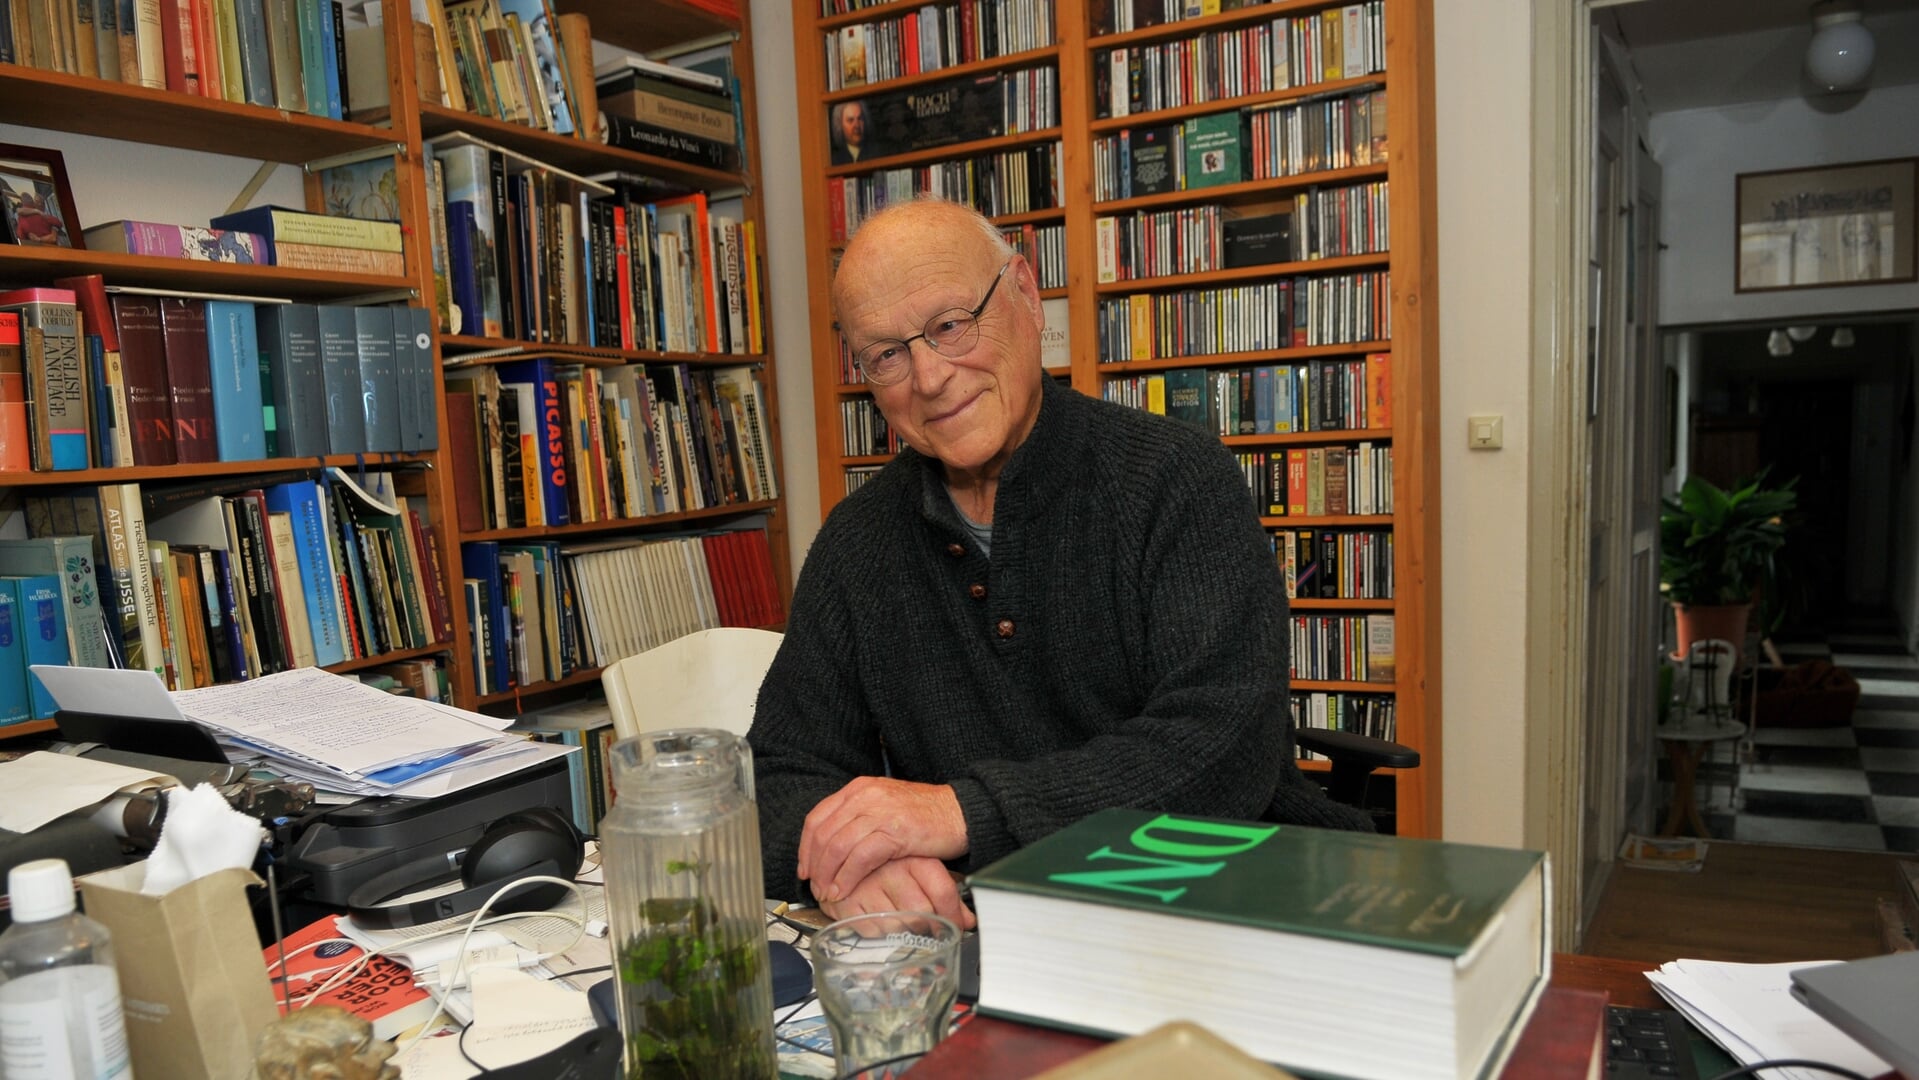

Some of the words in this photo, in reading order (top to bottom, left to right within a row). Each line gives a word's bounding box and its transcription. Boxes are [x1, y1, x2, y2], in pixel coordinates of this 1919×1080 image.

[630, 126, 668, 146] Leonardo
[670, 136, 679, 148] da
[680, 138, 700, 154] Vinci
[41, 307, 73, 318] COLLINS
[41, 316, 74, 327] COBUILD
[44, 335, 66, 417] LANGUAGE
[60, 335, 81, 402] ENGLISH
[543, 381, 566, 487] PICASSO
[646, 382, 657, 416] H.N.
[652, 420, 670, 496] Werkman
[107, 507, 124, 550] ATLAS
[133, 519, 148, 562] Friesland
[116, 551, 125, 566] van
[119, 566, 127, 577] de
[140, 563, 149, 573] in
[119, 577, 136, 620] IJSSEL
[139, 573, 157, 626] vogelvlucht
[2, 635, 9, 645] 2
[336, 964, 404, 1000] EDER
[351, 976, 410, 1005] OOR
